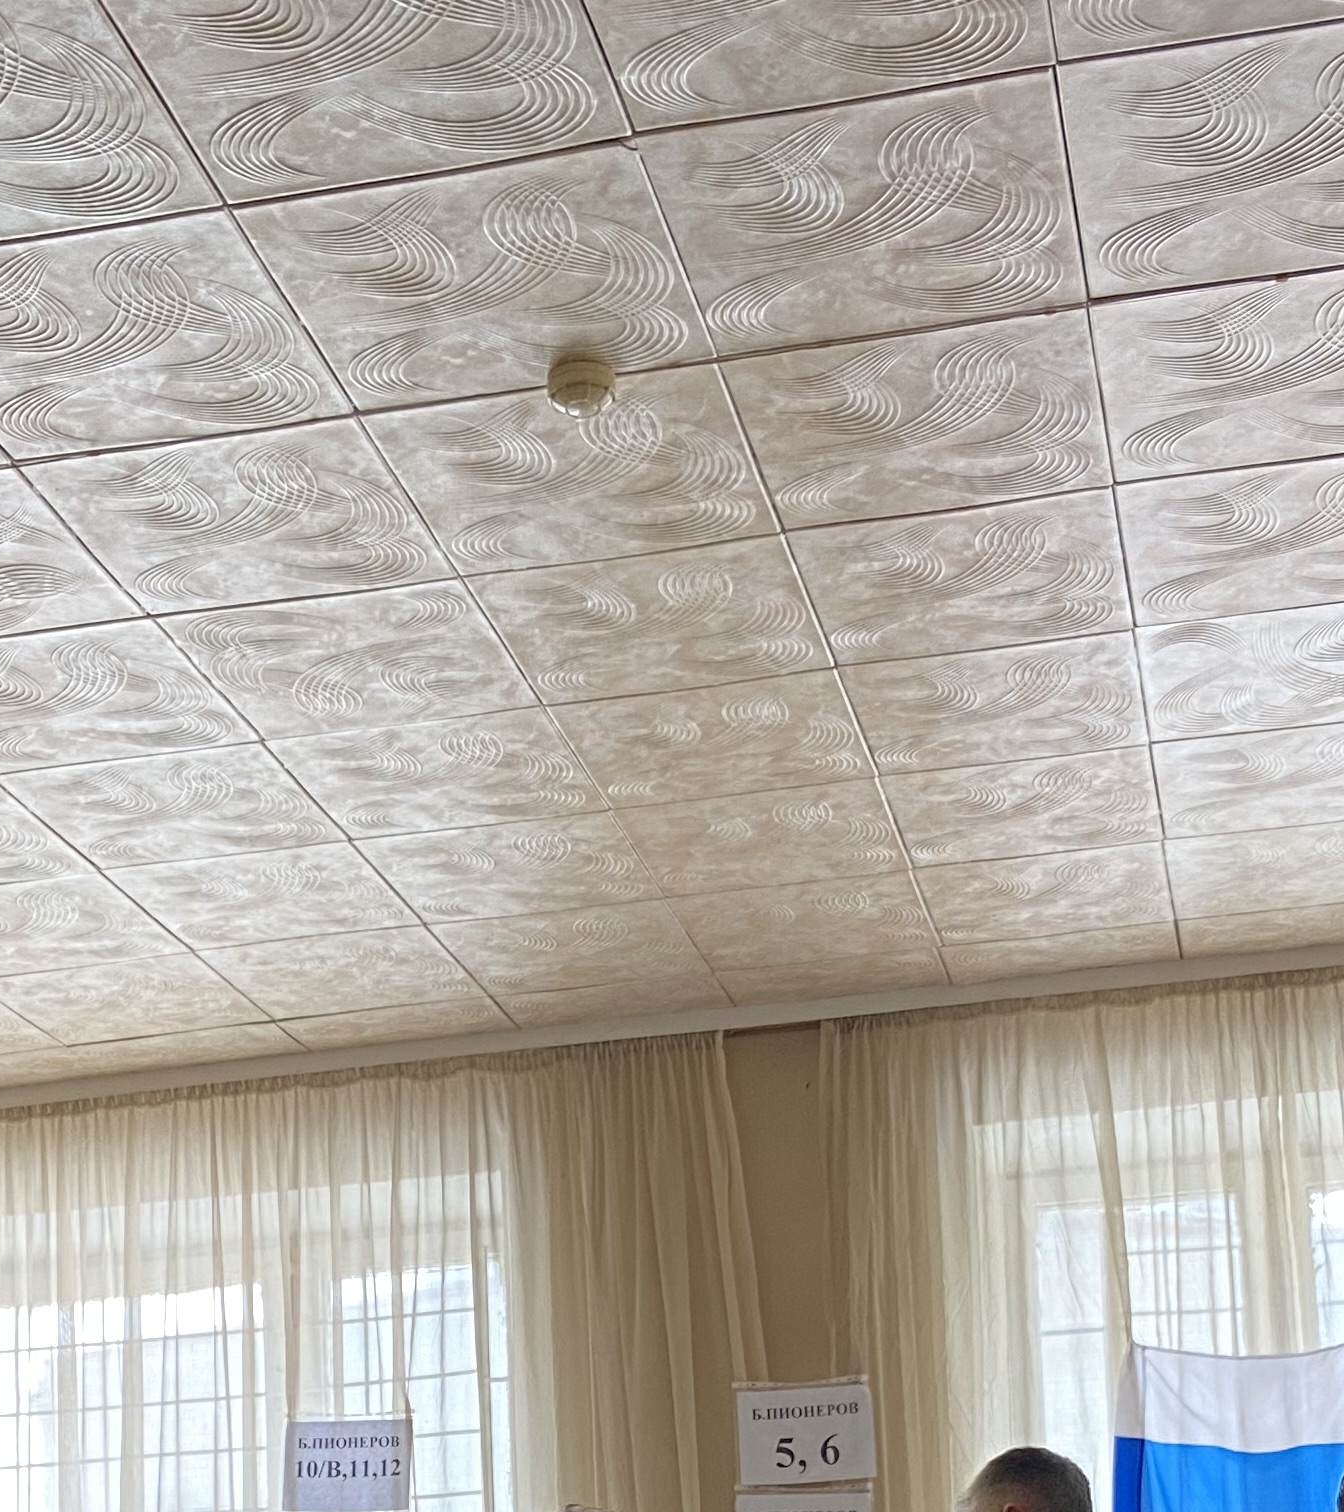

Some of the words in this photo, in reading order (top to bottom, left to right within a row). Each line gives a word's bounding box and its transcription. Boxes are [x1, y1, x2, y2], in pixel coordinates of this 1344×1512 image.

[752, 1403, 859, 1420] Б.ПИОНЕРОВ
[298, 1436, 400, 1449] Б.ПИОНЕРОВ
[775, 1437, 806, 1475] 5,
[820, 1434, 840, 1465] 6
[296, 1459, 401, 1481] 10/В,11,12
